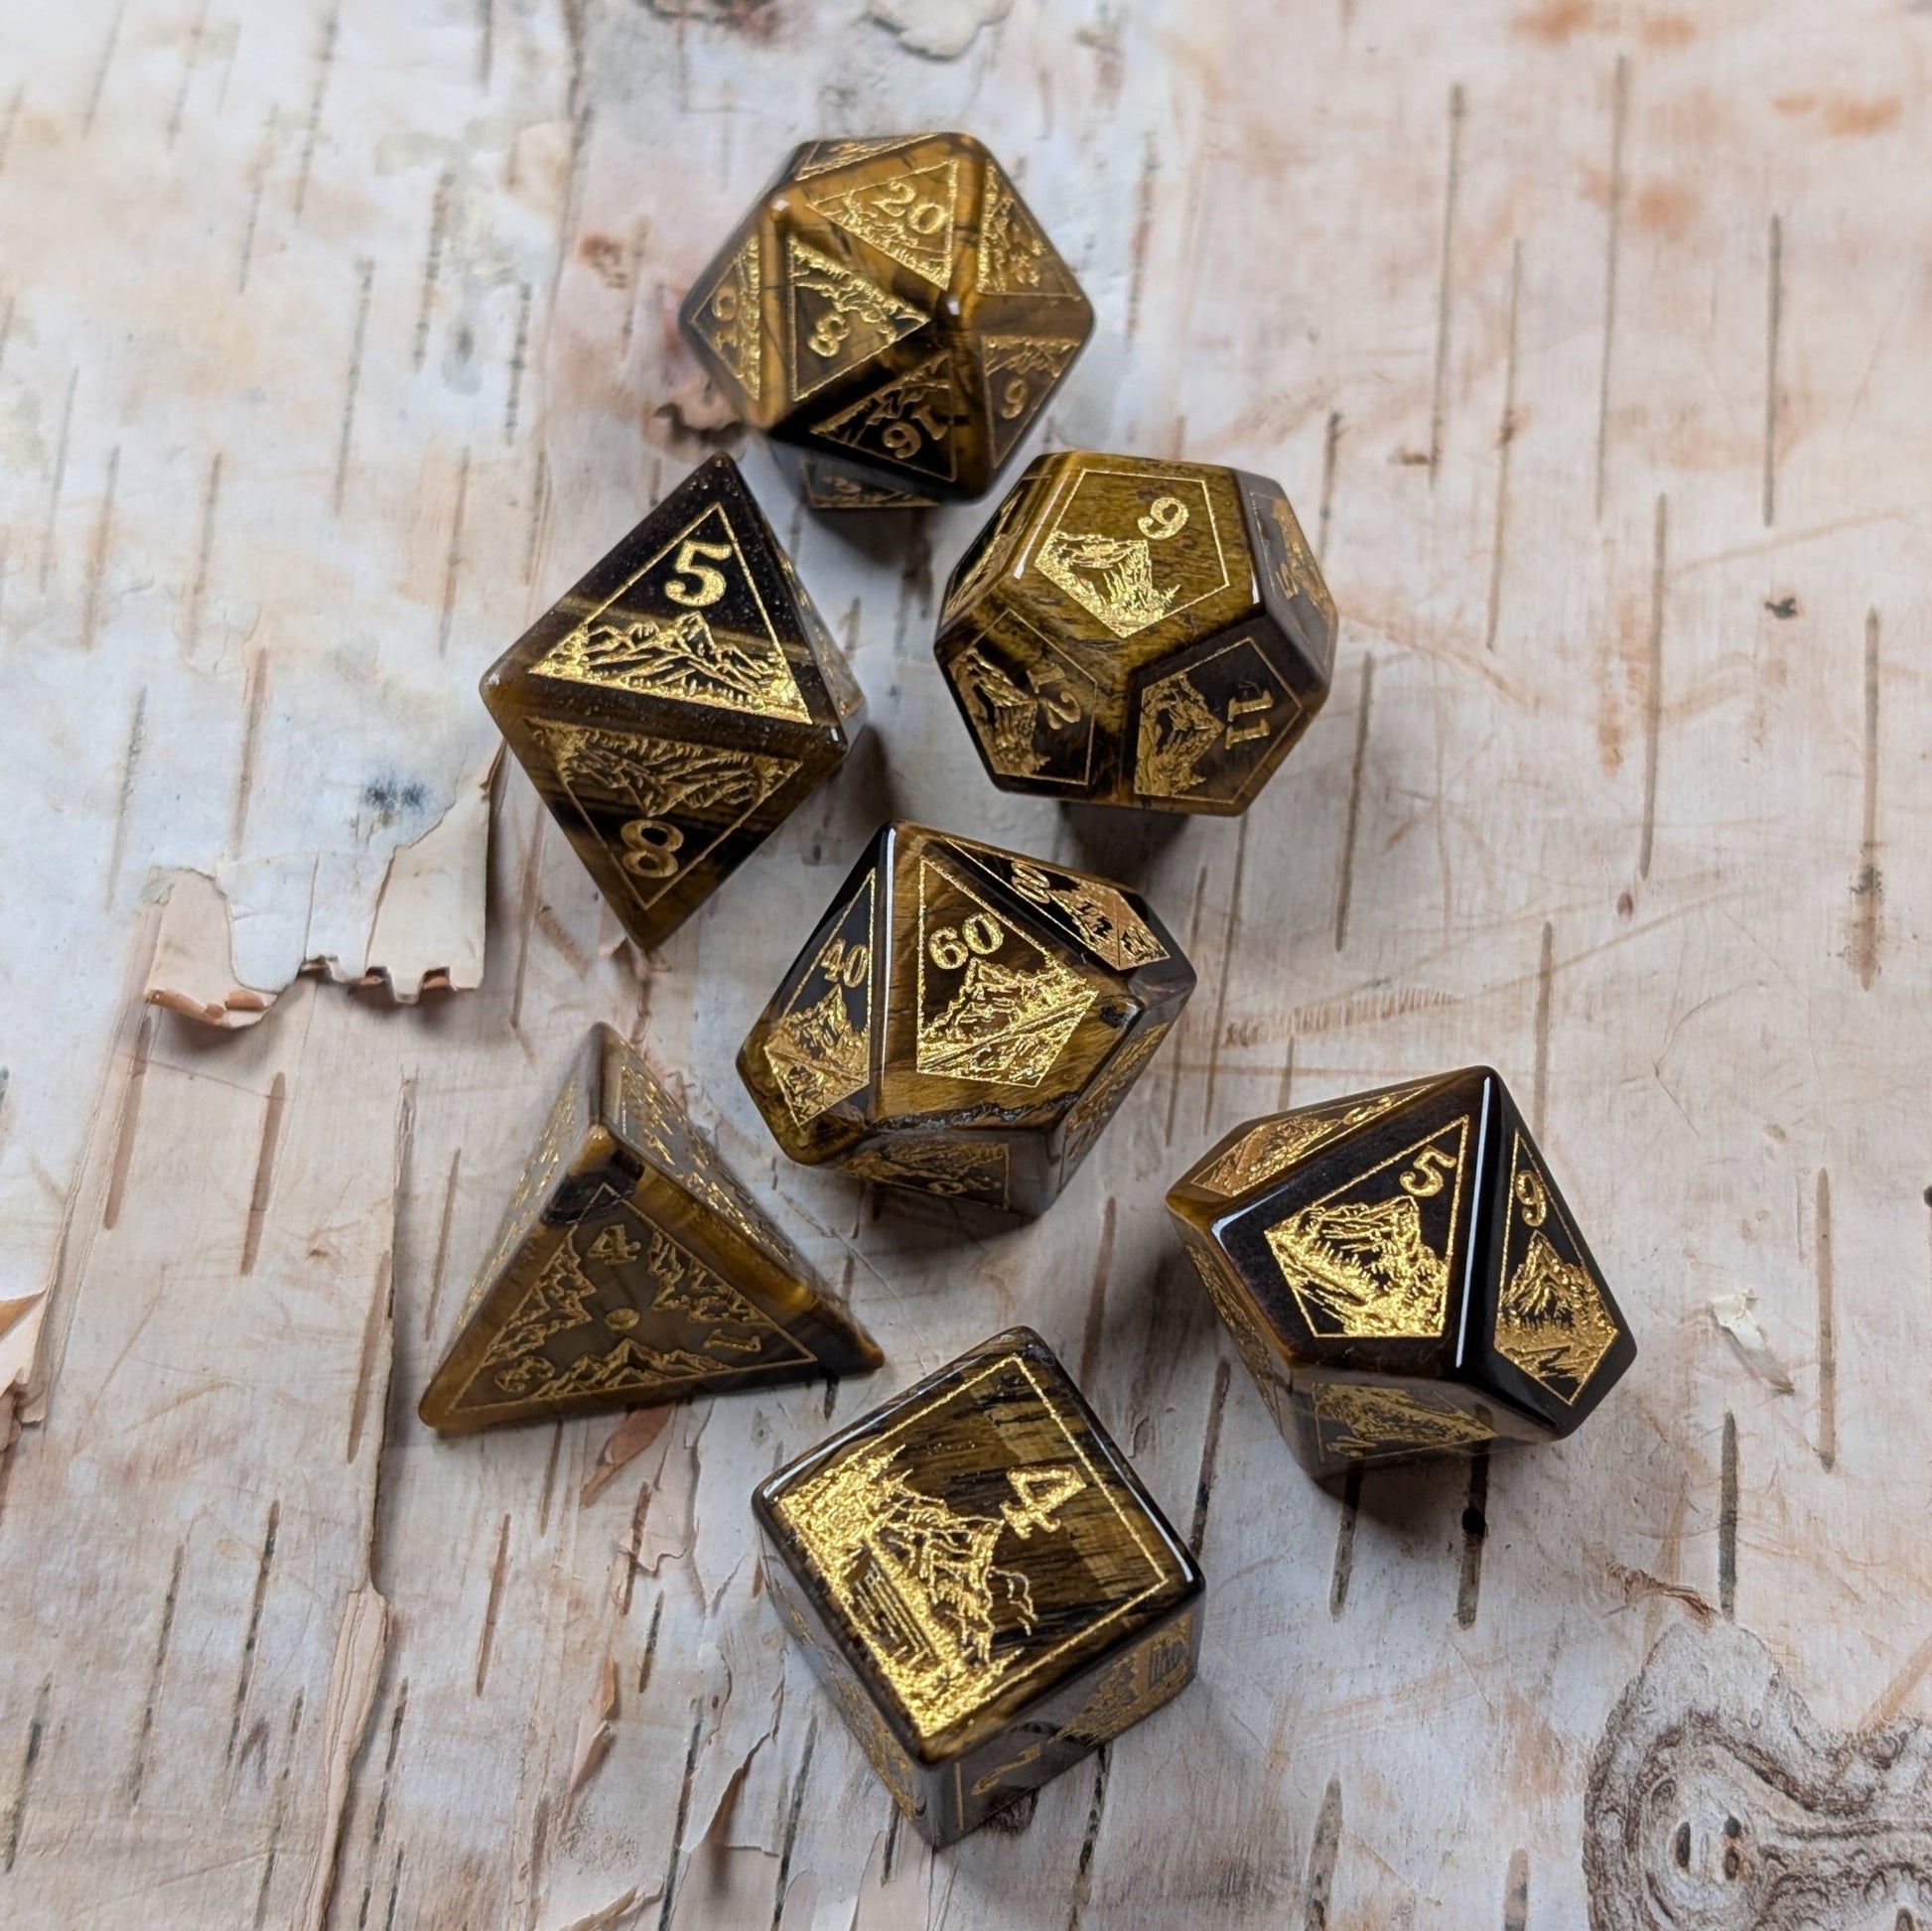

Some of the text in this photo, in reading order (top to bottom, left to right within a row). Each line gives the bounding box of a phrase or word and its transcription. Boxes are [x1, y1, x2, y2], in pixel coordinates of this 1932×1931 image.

[872, 178, 947, 234] 20
[711, 288, 738, 349] 10
[808, 314, 851, 357] 8
[882, 405, 949, 460] 16
[663, 541, 733, 607] 5
[1026, 663, 1082, 730] 12
[1224, 690, 1274, 750] 11
[621, 819, 685, 879] 8
[820, 938, 870, 988] 40
[929, 912, 1004, 970] 60
[1399, 1146, 1456, 1197] 5
[1517, 1170, 1548, 1227] 9
[587, 1224, 641, 1265] 4
[704, 1328, 761, 1352] 1
[1000, 1464, 1087, 1540] 4
